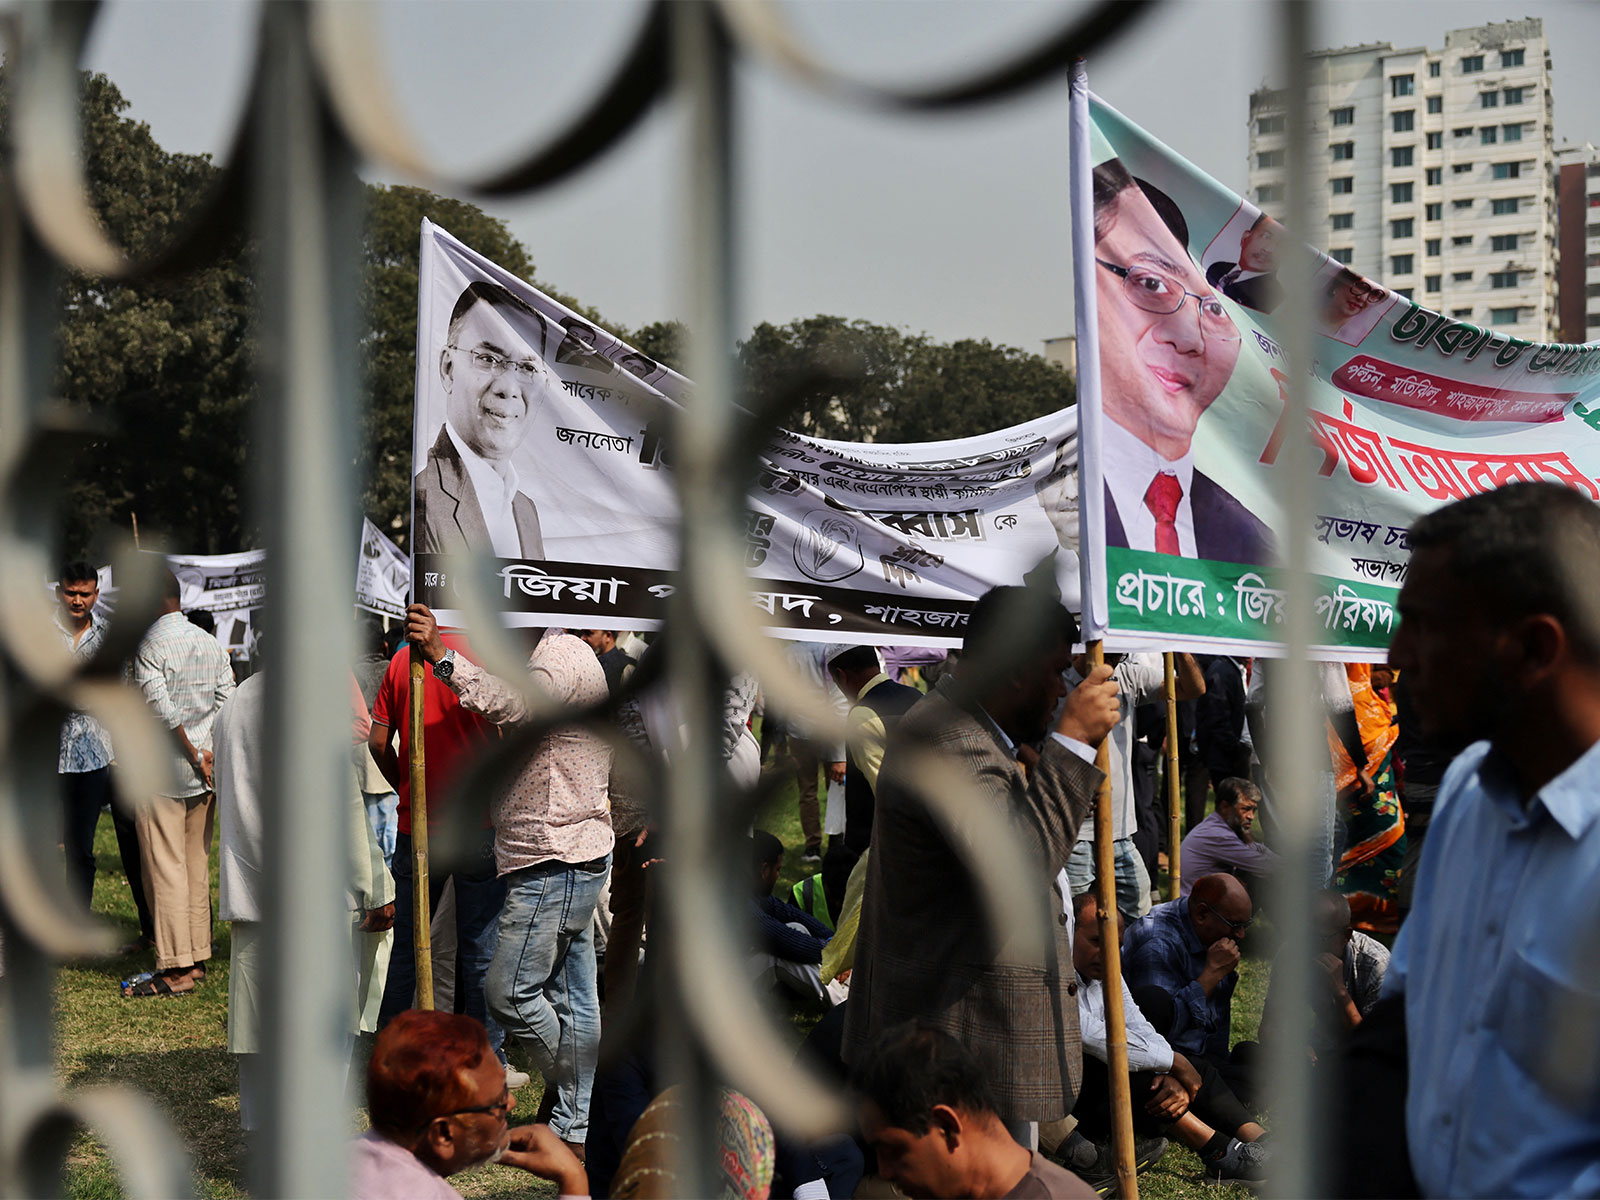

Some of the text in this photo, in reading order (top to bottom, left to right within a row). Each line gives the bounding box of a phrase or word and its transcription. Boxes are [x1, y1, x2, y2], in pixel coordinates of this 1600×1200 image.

[561, 379, 613, 403] সাবেক
[1347, 361, 1387, 392] পল্টন,
[556, 426, 634, 454] জননেতা
[994, 513, 1019, 530] কে
[1314, 514, 1381, 546] সুভাষ
[496, 564, 631, 605] জিয়া
[1350, 556, 1409, 584] সভাপ
[1115, 567, 1207, 619] প্রচারে
[1312, 583, 1394, 635] পরিষদ
